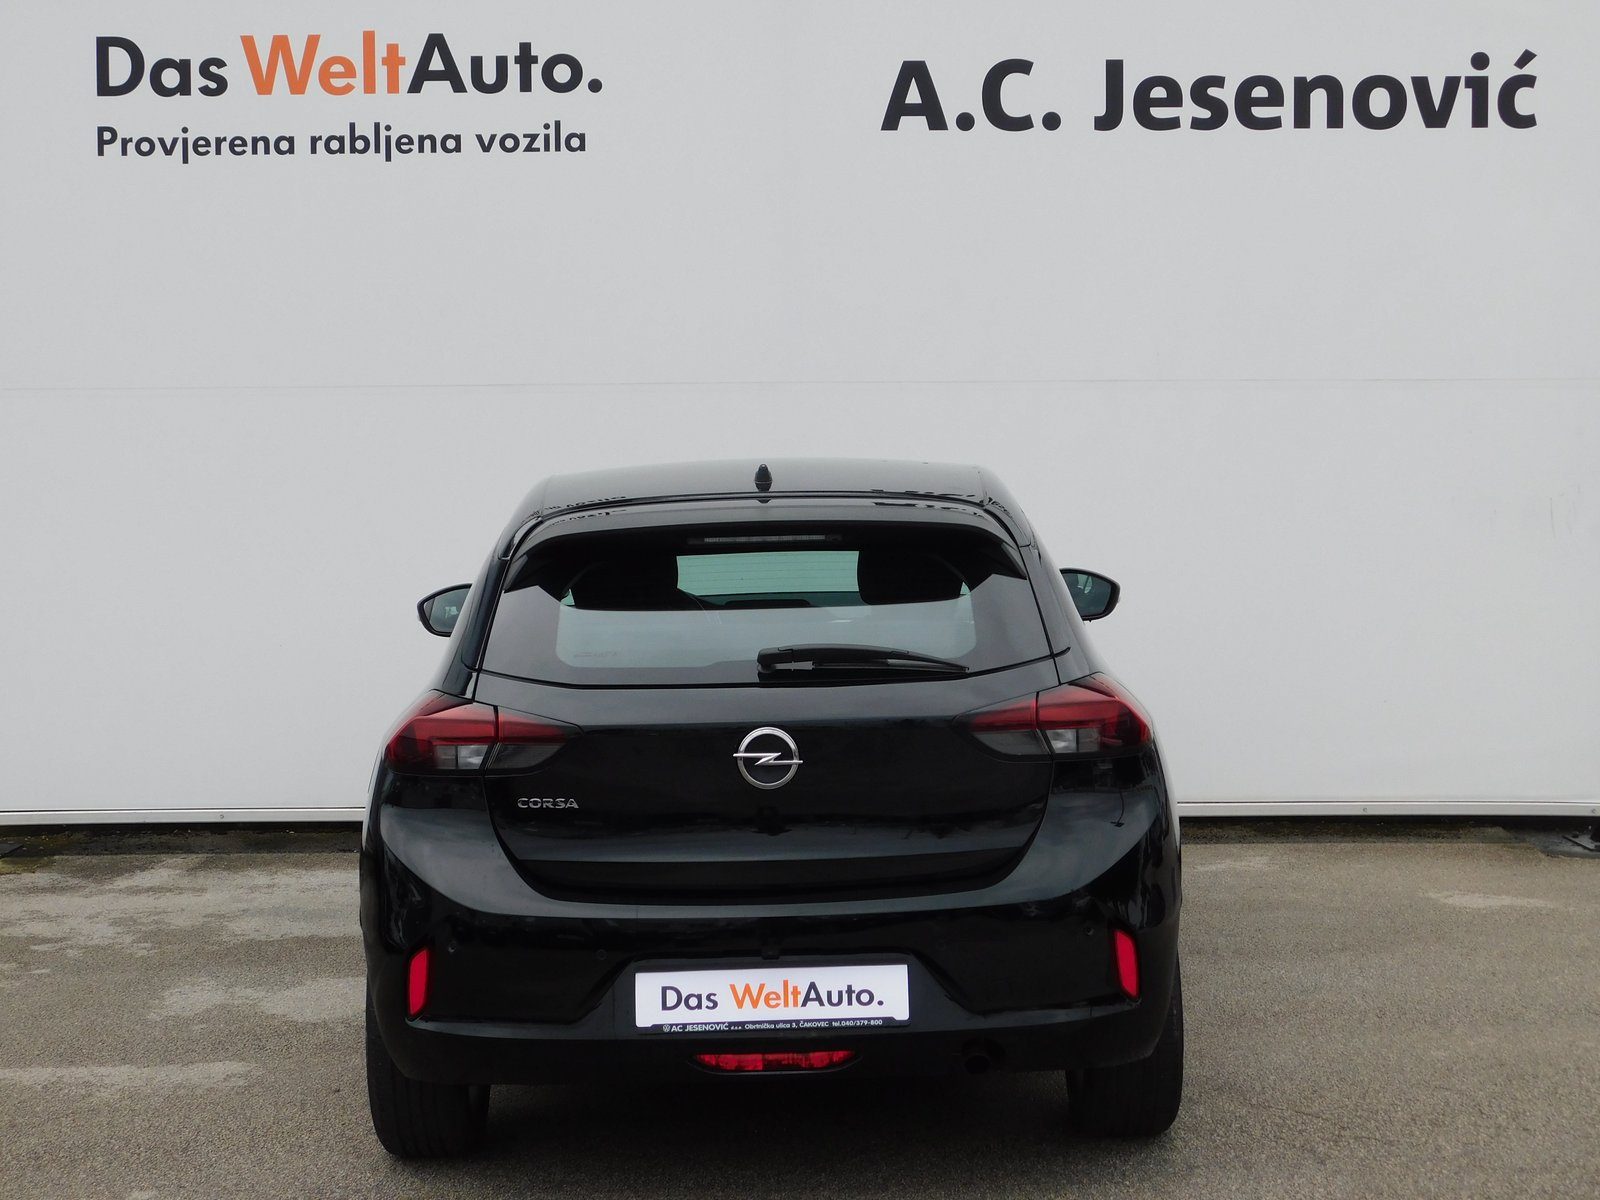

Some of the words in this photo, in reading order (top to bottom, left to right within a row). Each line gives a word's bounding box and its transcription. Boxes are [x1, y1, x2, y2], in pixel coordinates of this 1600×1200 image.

[96, 37, 228, 97] Das
[241, 31, 603, 96] WeltAuto.
[881, 59, 1062, 131] A.C.
[1094, 49, 1538, 131] Jesenović
[97, 126, 295, 164] Provjerena
[310, 122, 462, 162] rabljena
[476, 120, 587, 153] vozila
[517, 797, 580, 809] CORSA
[661, 986, 718, 1011] Das
[729, 979, 884, 1010] WeltAuto.
[685, 1023, 729, 1032] JESENOVIĆ
